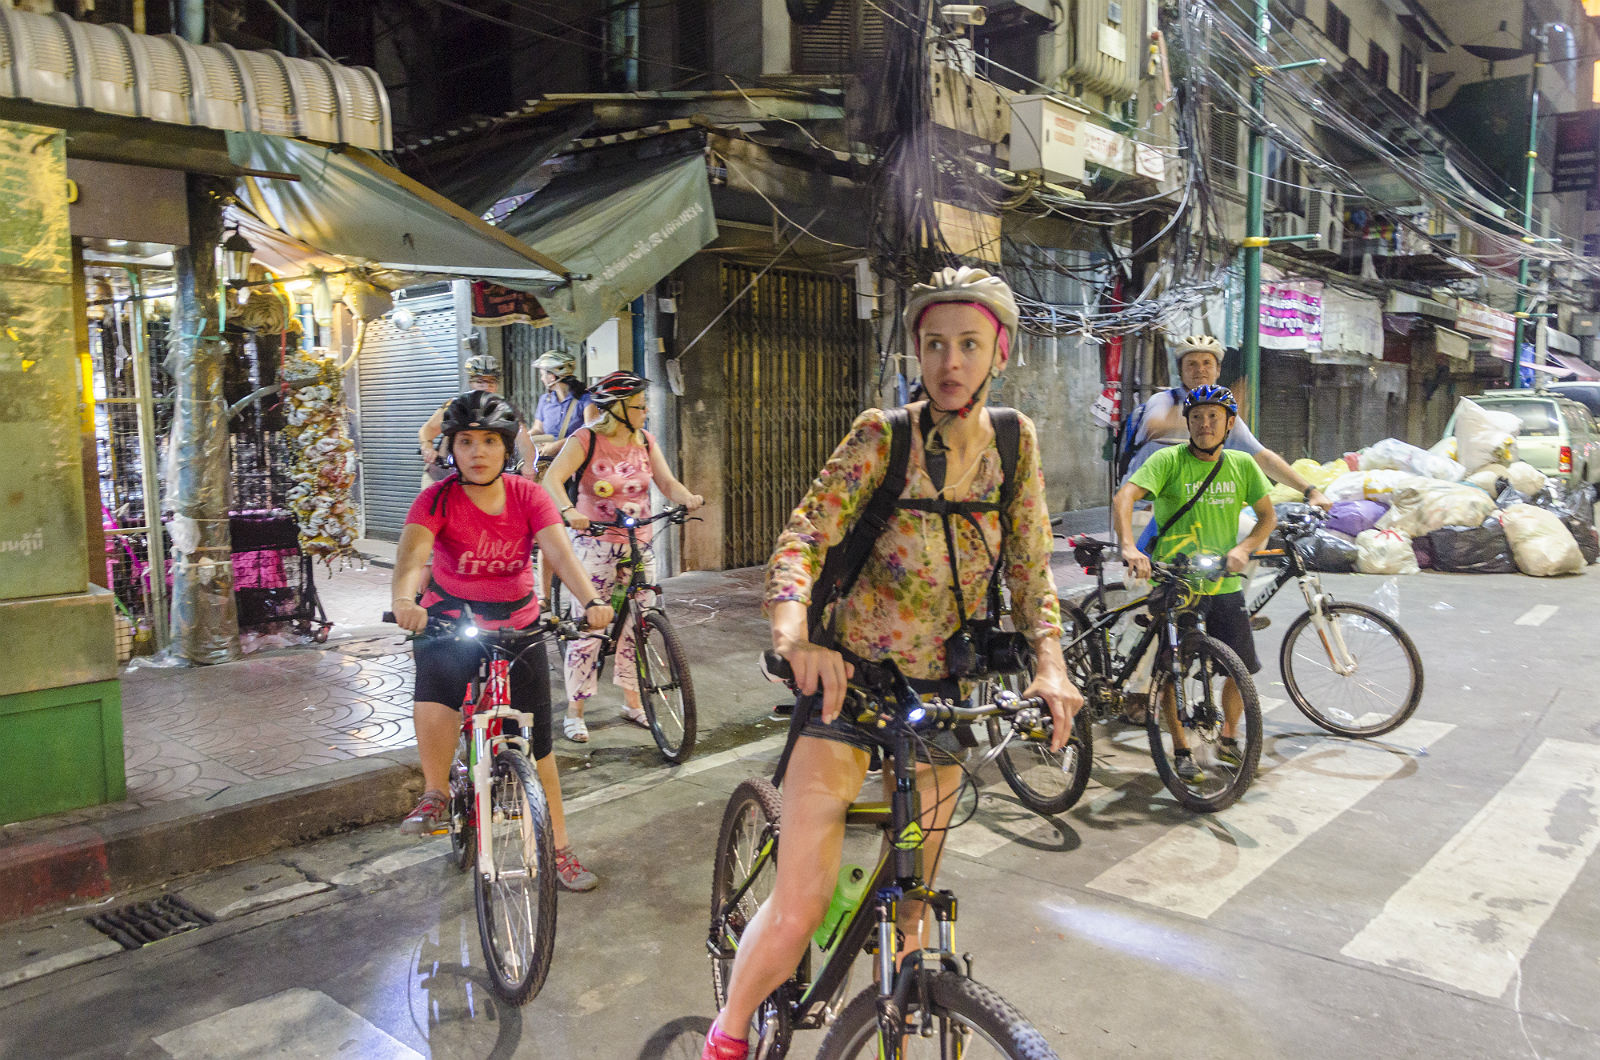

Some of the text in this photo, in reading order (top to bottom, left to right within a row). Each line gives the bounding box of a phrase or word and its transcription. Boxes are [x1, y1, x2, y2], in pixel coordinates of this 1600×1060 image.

[1185, 481, 1236, 494] THLAND
[475, 529, 524, 559] live
[455, 550, 525, 575] free
[1248, 579, 1279, 616] RIDA
[713, 957, 724, 1002] RIDA
